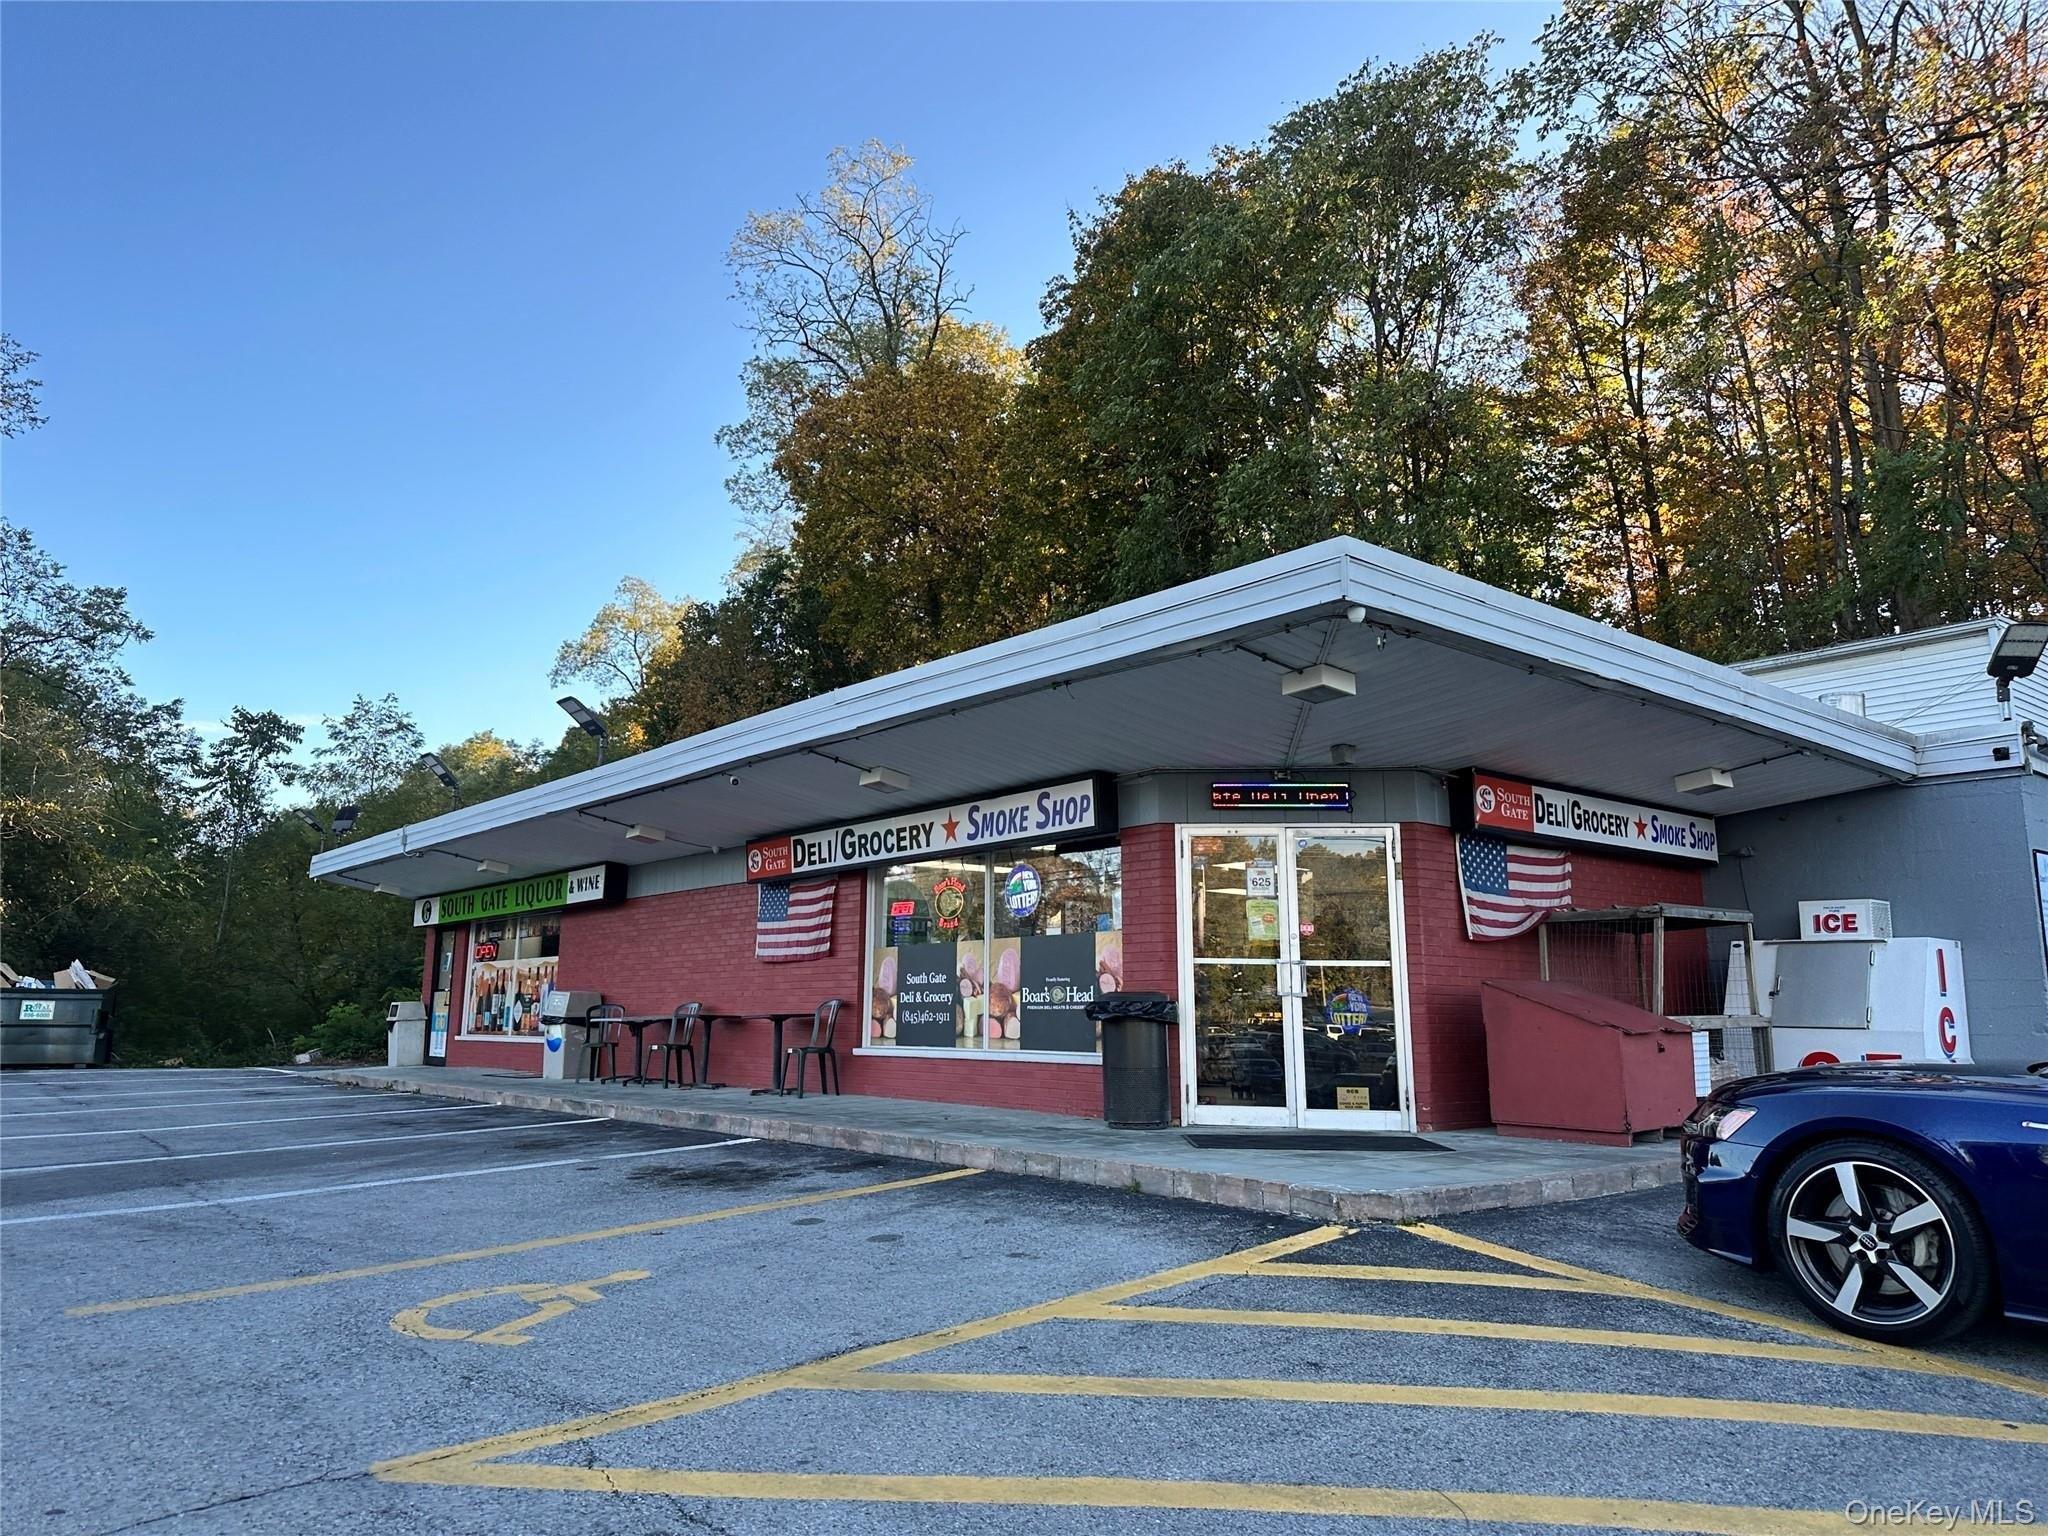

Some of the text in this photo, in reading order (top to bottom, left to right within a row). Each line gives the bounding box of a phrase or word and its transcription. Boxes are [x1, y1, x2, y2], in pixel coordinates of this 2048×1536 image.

[1651, 814, 1686, 848] SMOKE
[1689, 821, 1716, 852] SHOP
[441, 894, 475, 919] SOUTH
[481, 888, 509, 913] GATE
[515, 878, 564, 911] LIQUOR
[569, 883, 575, 895] &
[576, 874, 601, 893] WINE
[1813, 913, 1858, 934] ICE
[906, 972, 947, 985] South Gate
[900, 991, 953, 1005] Deli & Grocery
[1022, 985, 1094, 1003] Boar's Head
[902, 1010, 950, 1024] (845)462-1911
